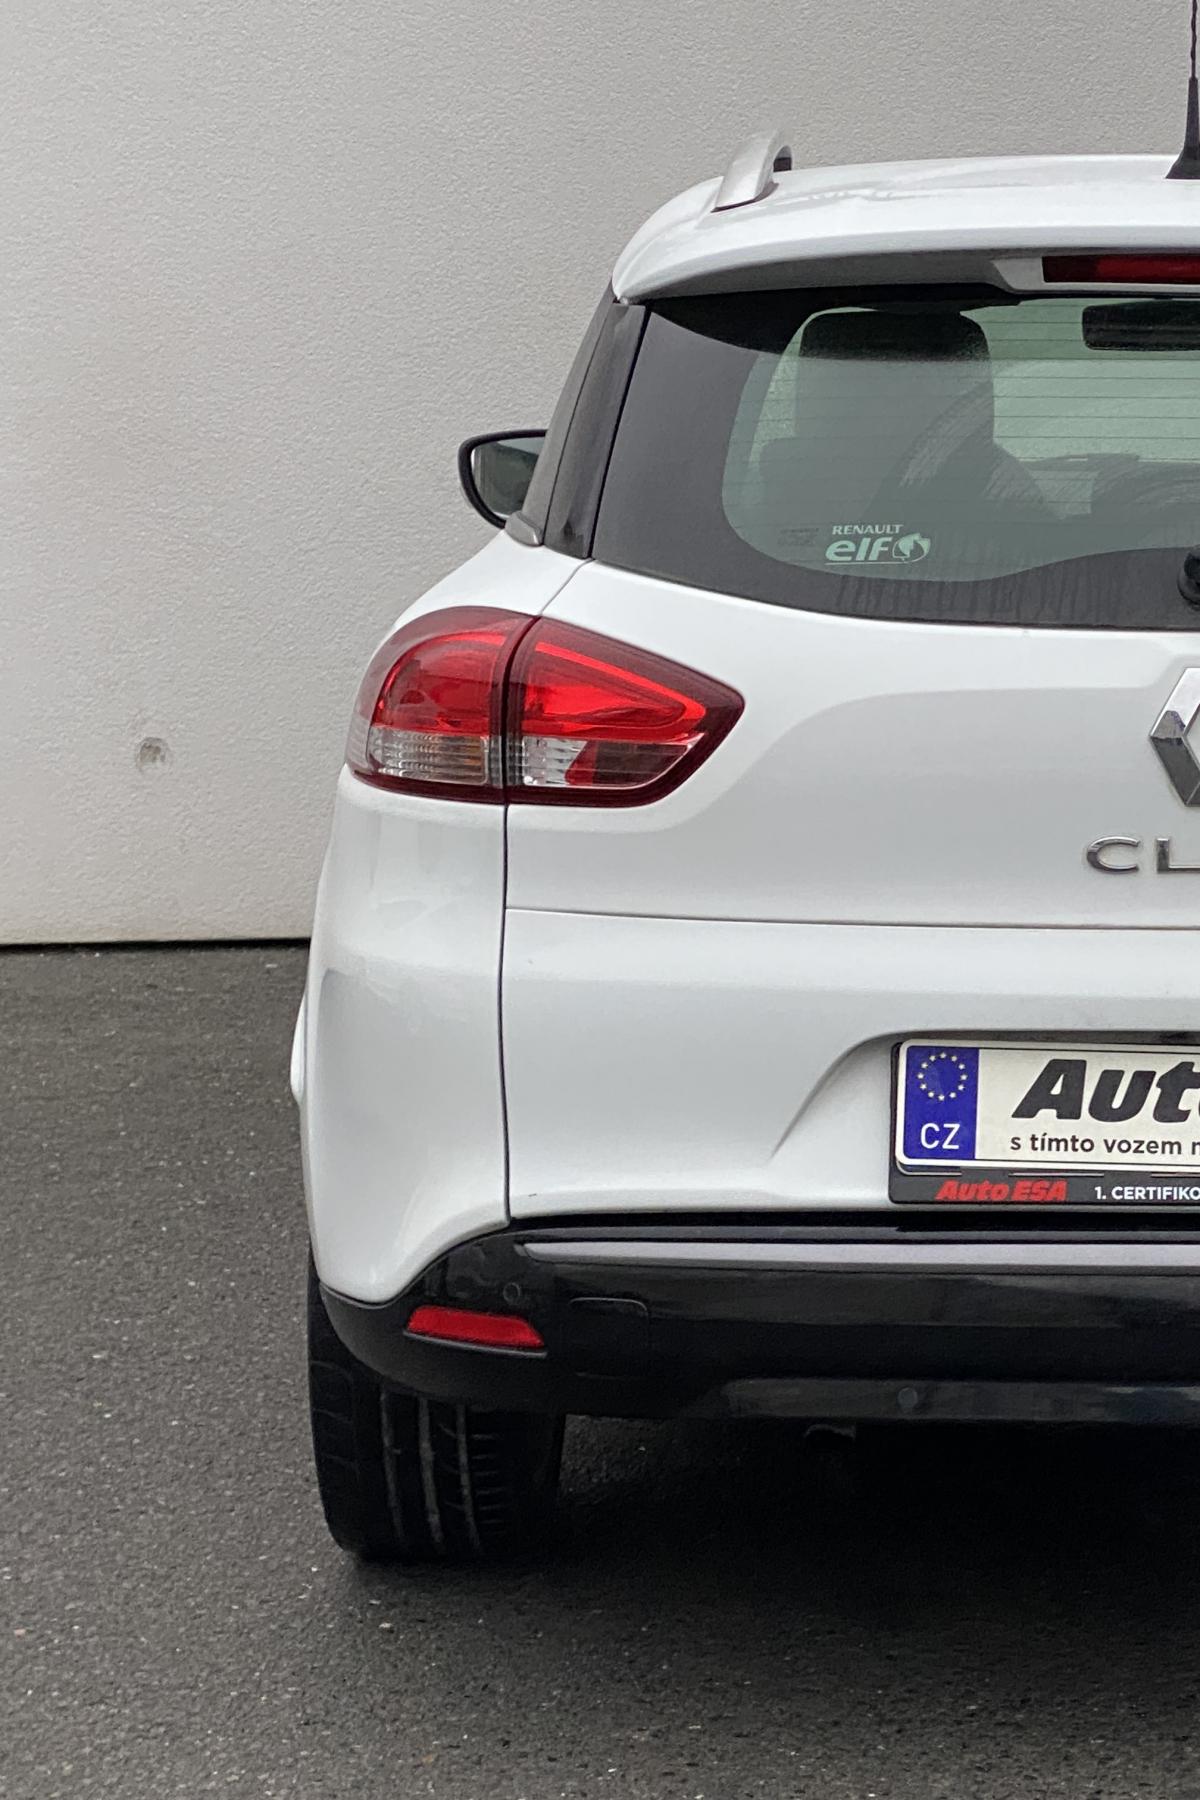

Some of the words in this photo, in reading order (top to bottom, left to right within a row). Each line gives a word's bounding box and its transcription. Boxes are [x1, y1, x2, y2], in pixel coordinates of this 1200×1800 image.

[831, 524, 903, 536] RENAULT
[825, 536, 894, 562] elf
[919, 1123, 961, 1150] CZ
[1009, 1136, 1022, 1151] s
[1030, 1132, 1095, 1153] tímto
[1103, 1138, 1182, 1156] vozem
[935, 1180, 1009, 1201] Auto
[1010, 1180, 1069, 1201] ESA
[1094, 1186, 1107, 1200] 1.
